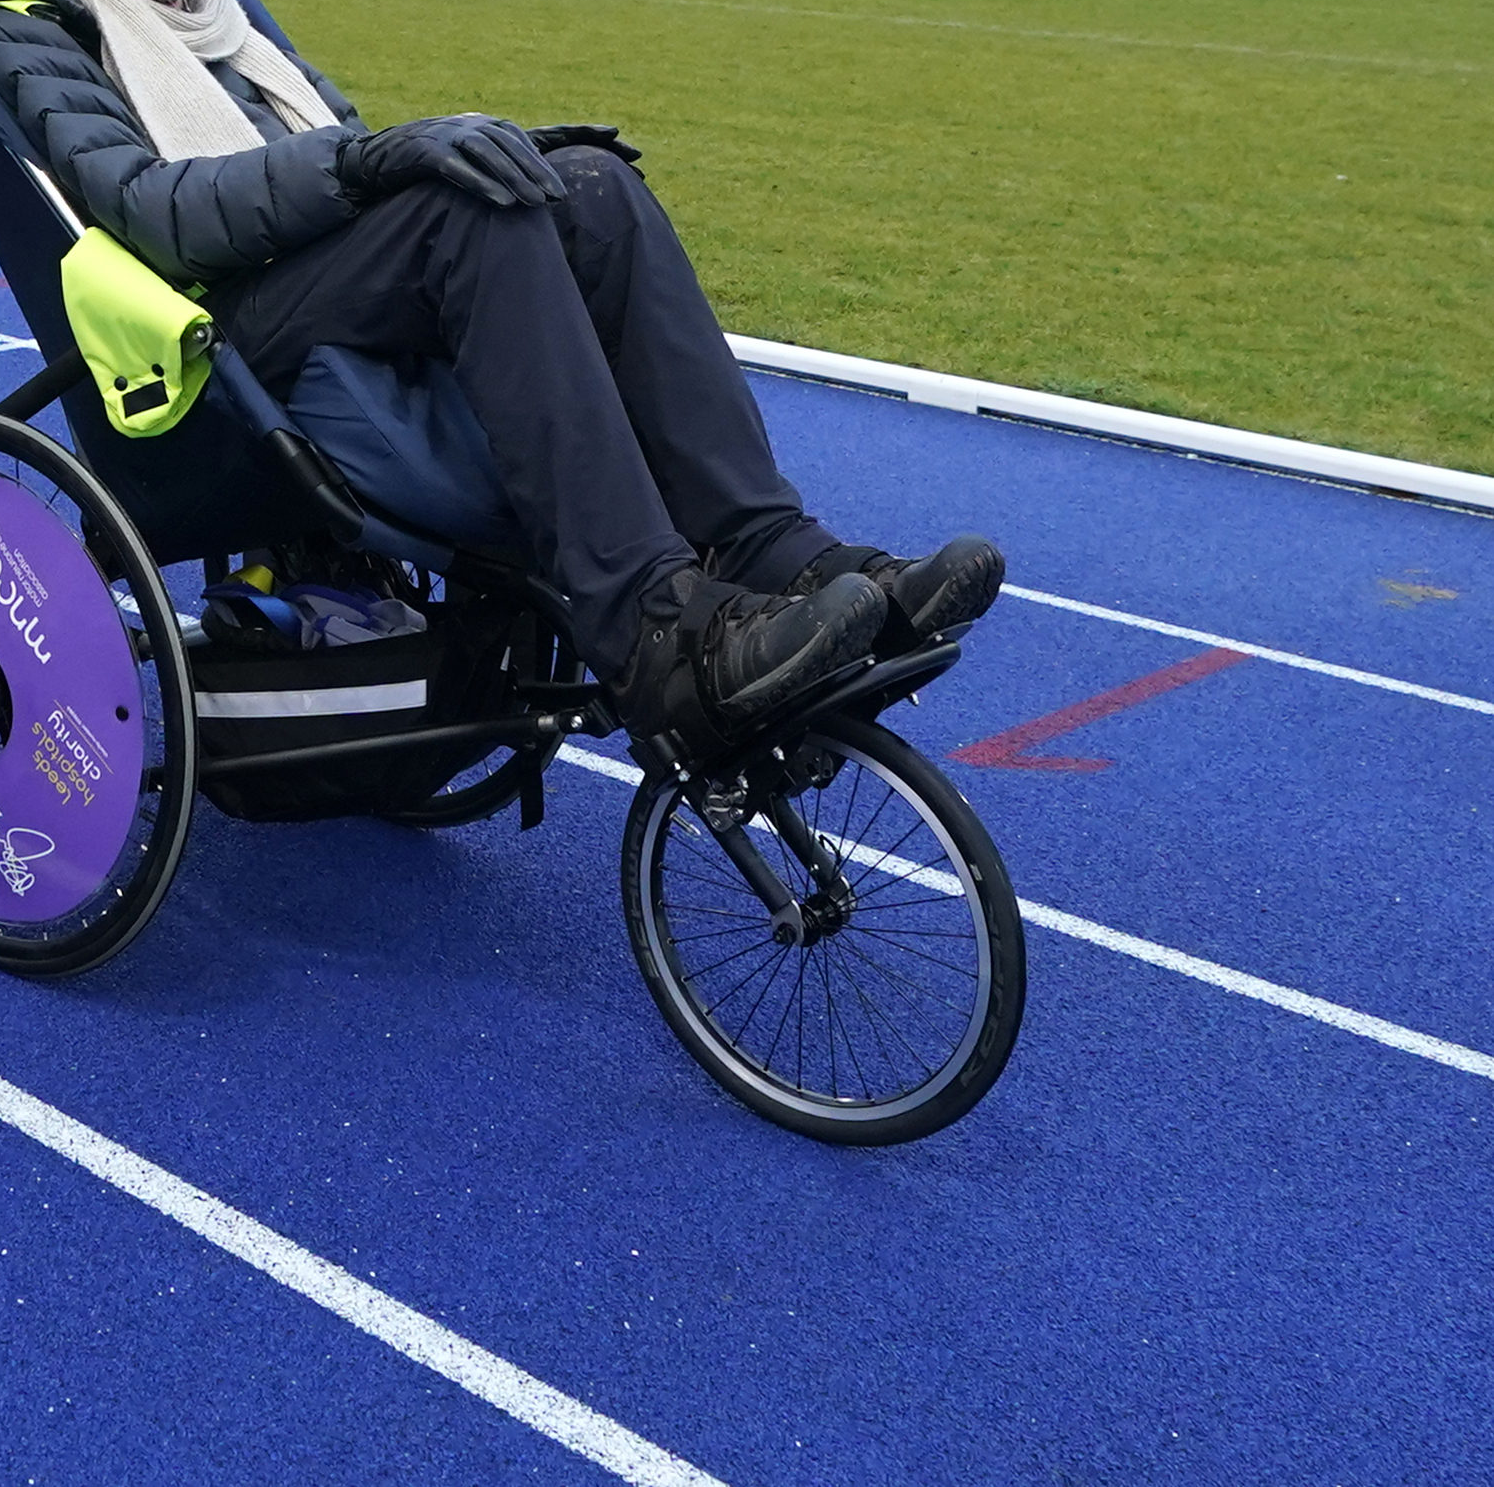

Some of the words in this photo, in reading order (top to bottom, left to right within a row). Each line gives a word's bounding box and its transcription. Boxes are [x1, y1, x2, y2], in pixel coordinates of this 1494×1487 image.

[0, 542, 24, 582] neurone
[14, 548, 49, 600] association
[22, 580, 43, 608] motor
[32, 721, 96, 807] hospitals
[47, 709, 102, 781] charity
[32, 750, 72, 805] leeds
